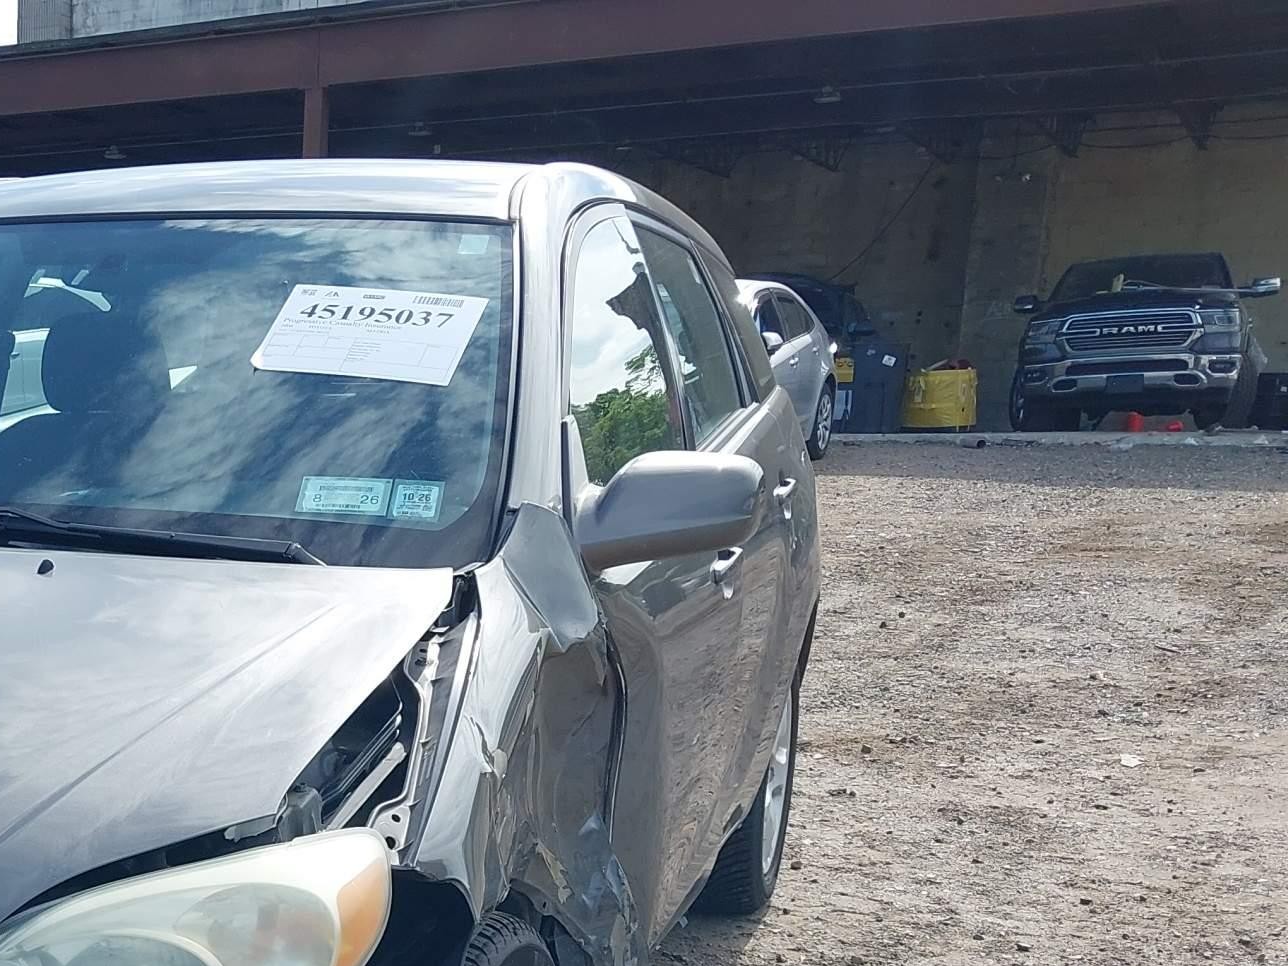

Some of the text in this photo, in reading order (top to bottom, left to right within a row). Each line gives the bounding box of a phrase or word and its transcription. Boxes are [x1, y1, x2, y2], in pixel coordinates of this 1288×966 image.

[300, 302, 455, 328] 45195037
[1102, 325, 1155, 335] RAM
[312, 494, 379, 505] 8 26
[403, 492, 432, 502] 10 26
